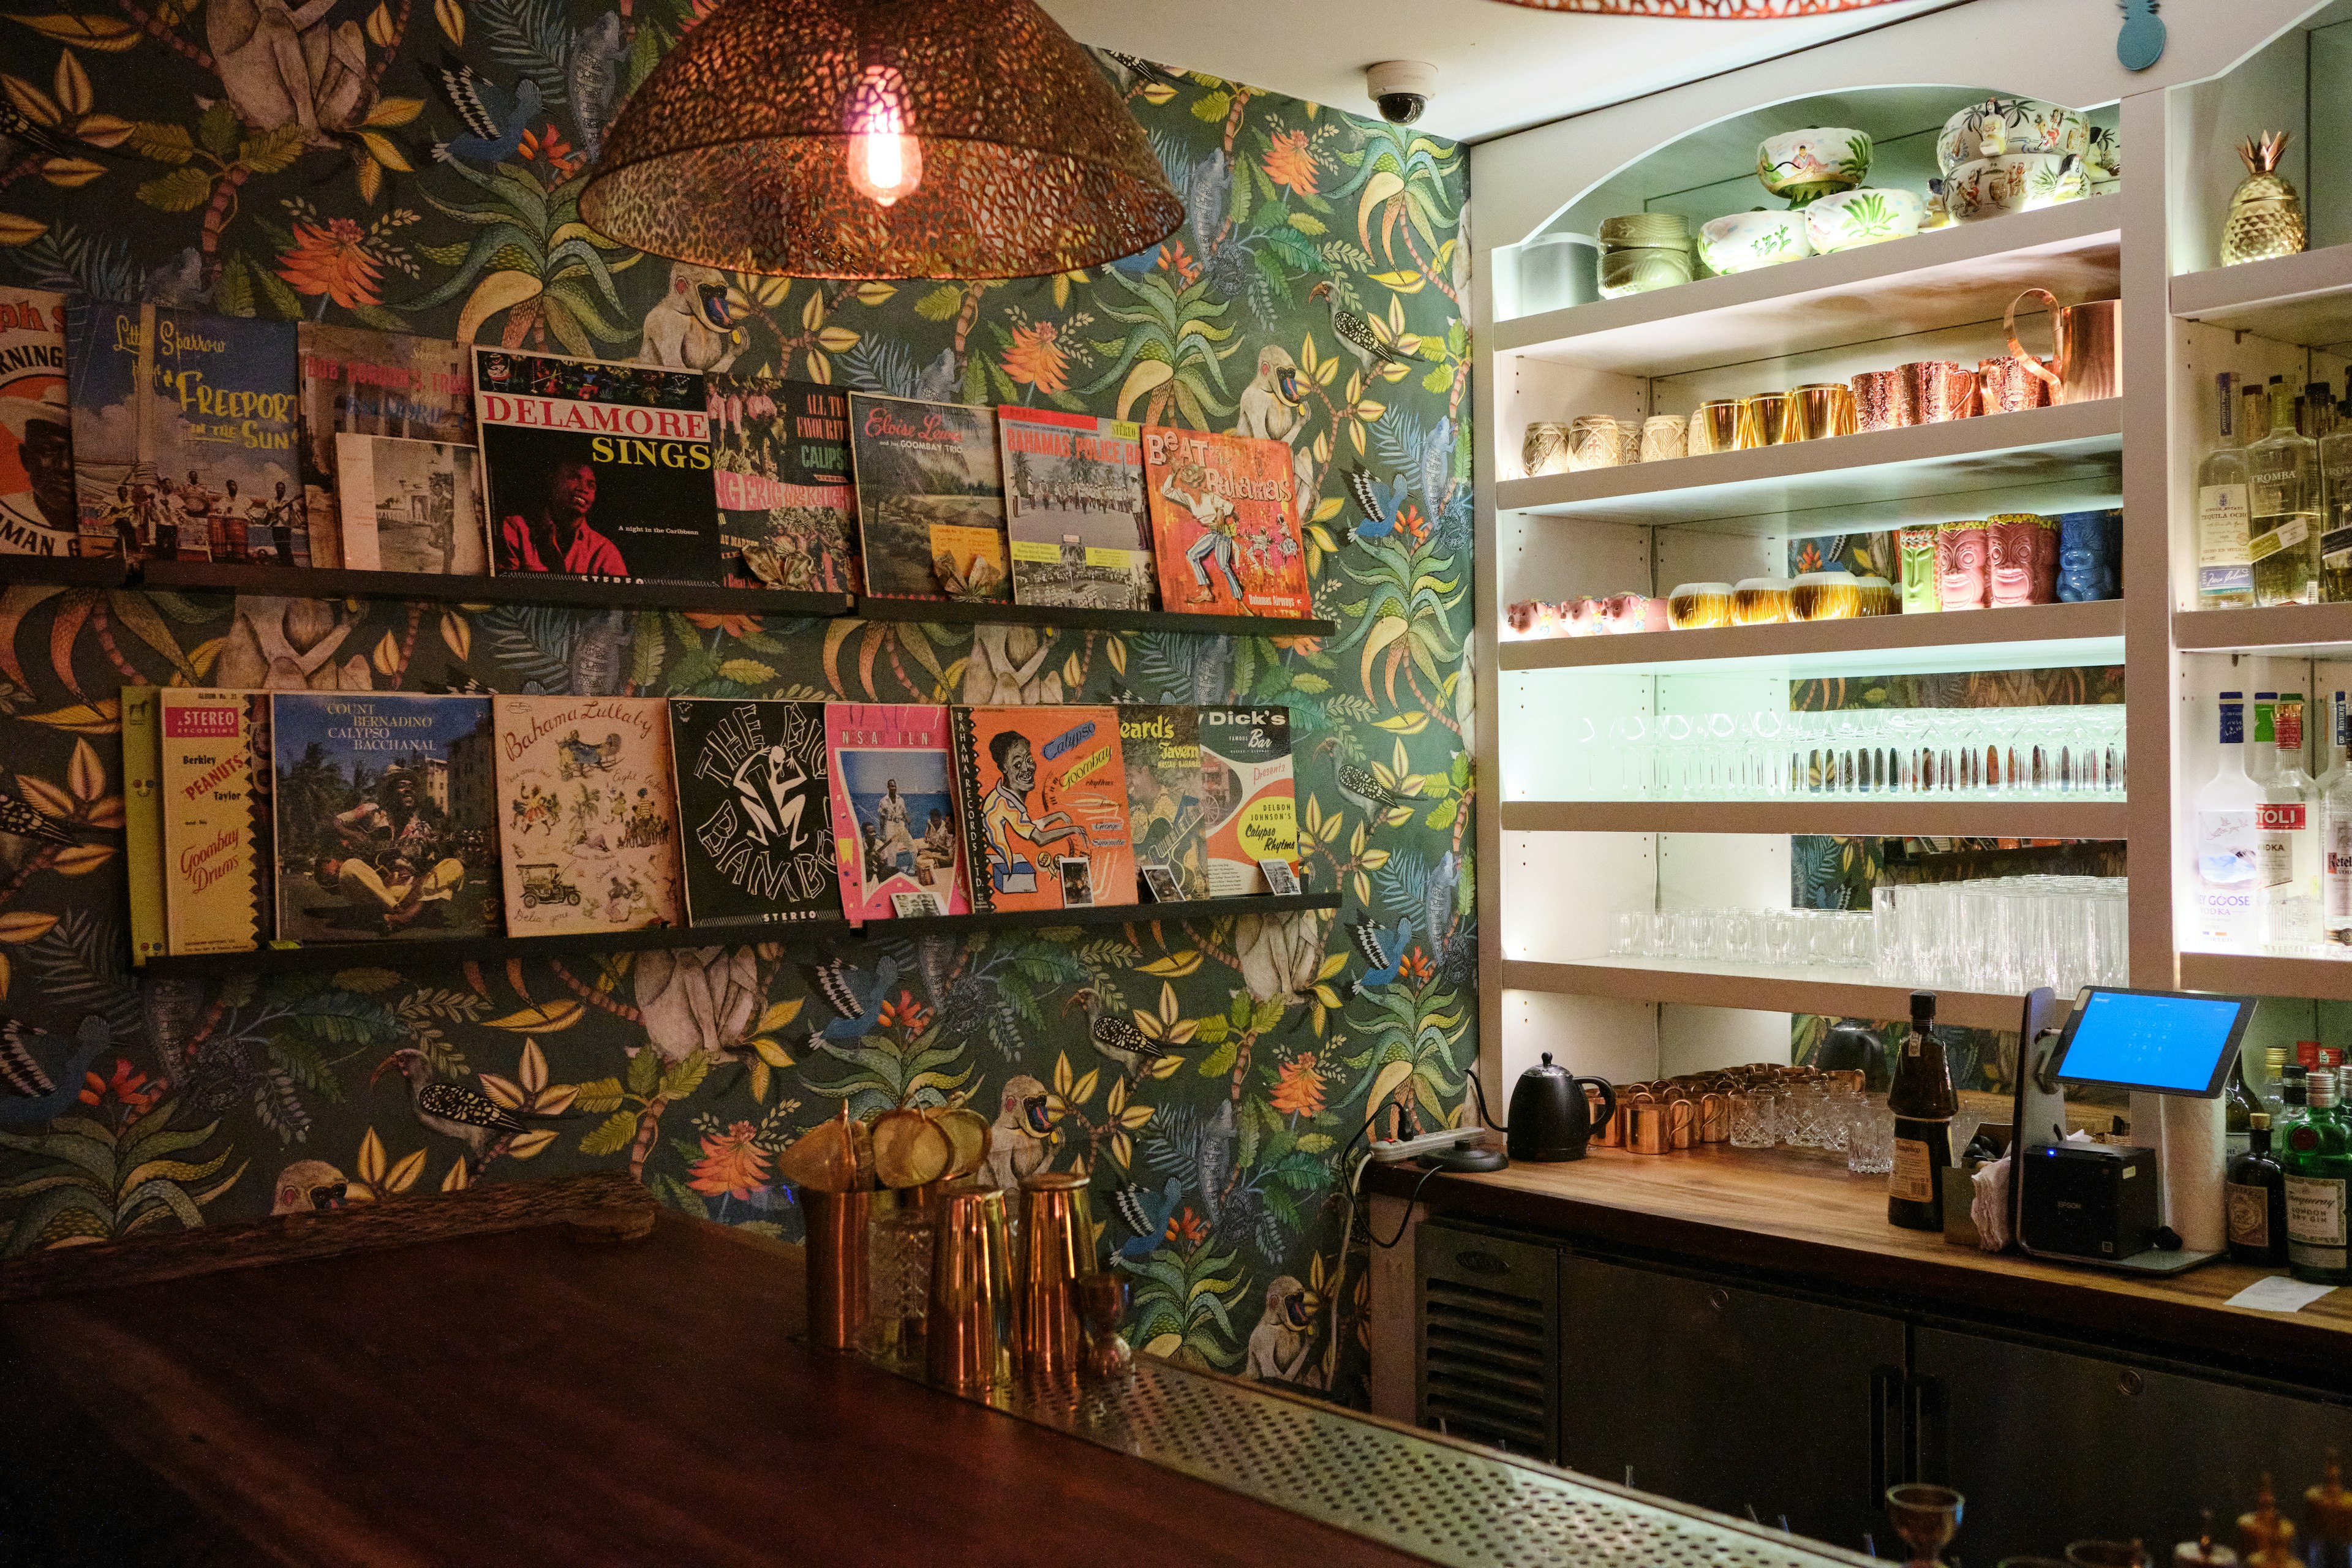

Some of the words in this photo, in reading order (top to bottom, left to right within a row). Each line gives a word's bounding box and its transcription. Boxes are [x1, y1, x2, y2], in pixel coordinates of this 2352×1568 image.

[160, 320, 225, 361] Sparrow
[483, 395, 707, 439] DELAMORE
[864, 407, 916, 437] Eloise
[1111, 424, 1136, 437] STEREO
[592, 436, 712, 470] SINGS
[900, 440, 943, 451] GOOMBAY
[944, 445, 963, 453] TRIO
[1006, 429, 1072, 458] BAHAMAS
[1075, 435, 1121, 464] POLICE
[2250, 470, 2296, 483] TROMBA
[0, 513, 55, 557] MAN
[1248, 594, 1272, 606] Bahamas
[1273, 595, 1295, 608] Airways
[184, 710, 235, 726] STEREO
[326, 704, 375, 715] COUNT
[1209, 710, 1286, 725] Dick's
[353, 715, 432, 727] BERNADINO
[328, 728, 390, 739] CALYPSO
[503, 707, 577, 762] Bahama
[580, 701, 652, 740] Lullaby
[1248, 728, 1273, 748] Bar
[354, 739, 437, 751] BACCHANAL
[693, 704, 765, 788] THE
[1043, 722, 1096, 760] Calypso
[183, 755, 216, 765] Berkley
[1158, 742, 1199, 760] Tavern
[1059, 745, 1112, 791] Goombay
[1254, 763, 1285, 785] Presents
[214, 791, 241, 802] Taylor
[958, 712, 970, 774] BAHAMA
[965, 778, 978, 852] RECORDS
[973, 856, 984, 888] LTD.
[1095, 822, 1120, 831] George
[1245, 823, 1276, 841] Calypso
[180, 827, 239, 881] Goombay
[696, 797, 837, 902] BAMBO
[192, 854, 239, 894] Drums
[2209, 895, 2250, 906] GOOSE
[763, 911, 817, 922] STEREO
[2057, 1200, 2082, 1210] EPSON
[2291, 1207, 2327, 1216] LONDON
